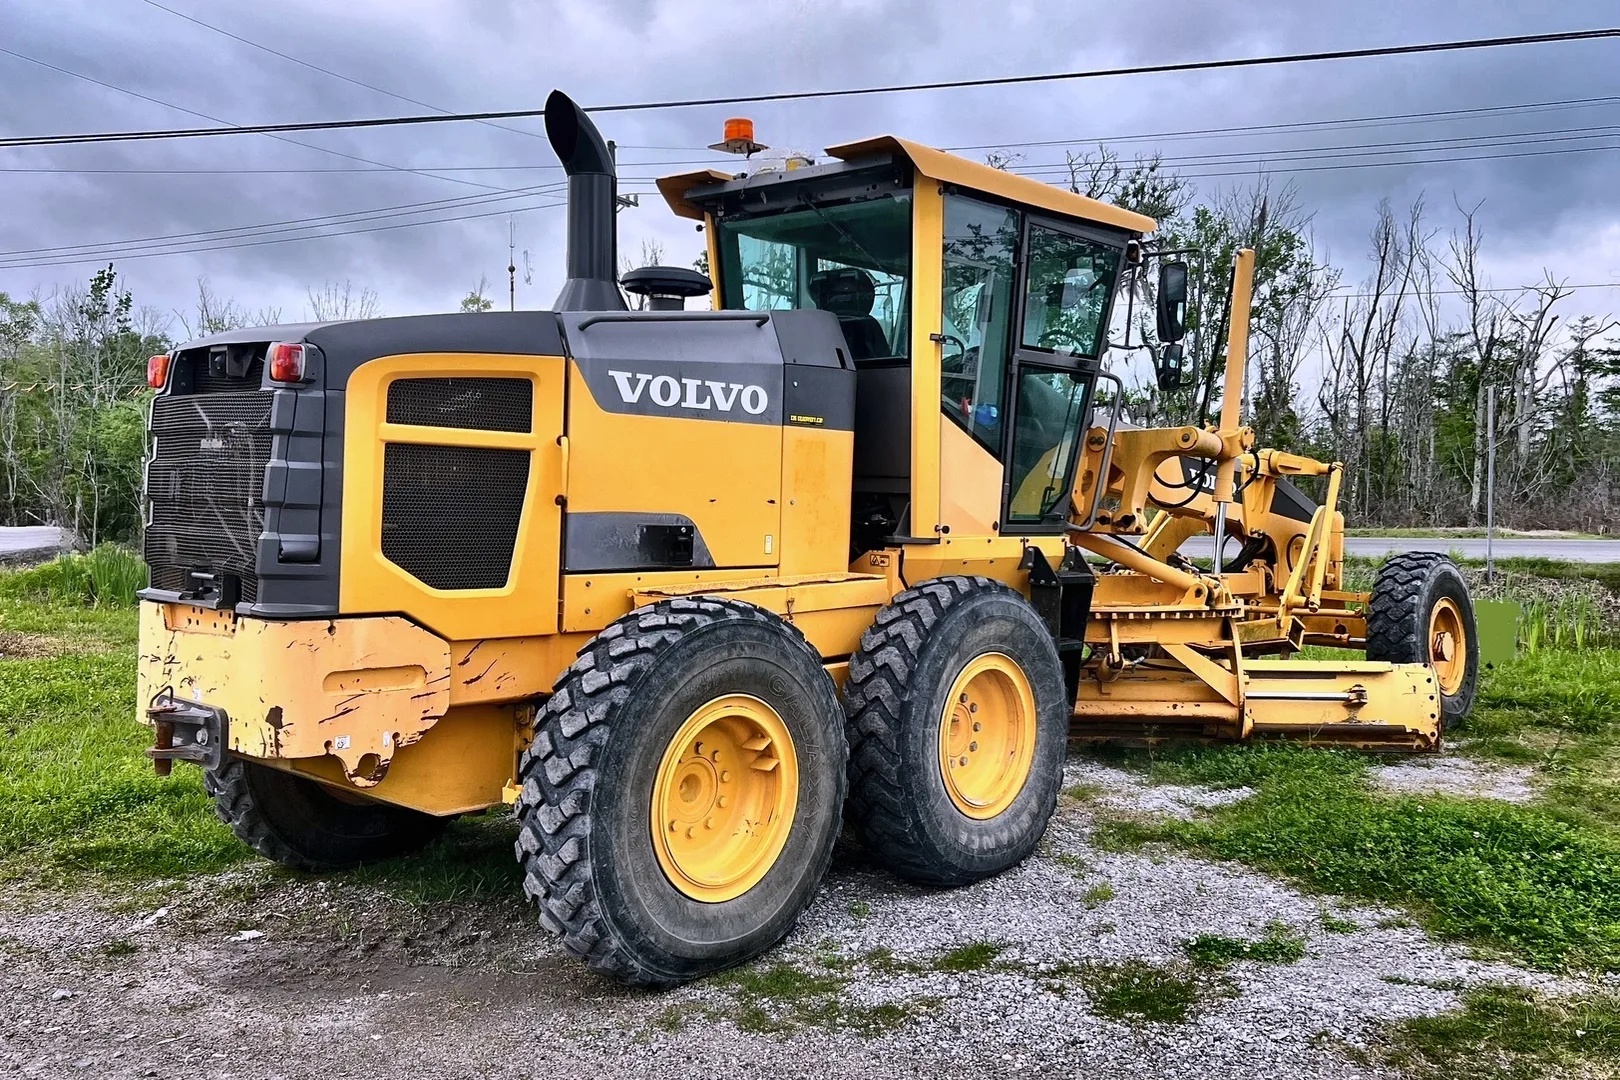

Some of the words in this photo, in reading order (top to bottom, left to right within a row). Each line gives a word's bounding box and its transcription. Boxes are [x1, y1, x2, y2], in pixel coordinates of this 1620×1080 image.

[608, 370, 768, 414] VOLVO
[1189, 468, 1237, 494] VOL
[767, 674, 822, 840] GALAXY
